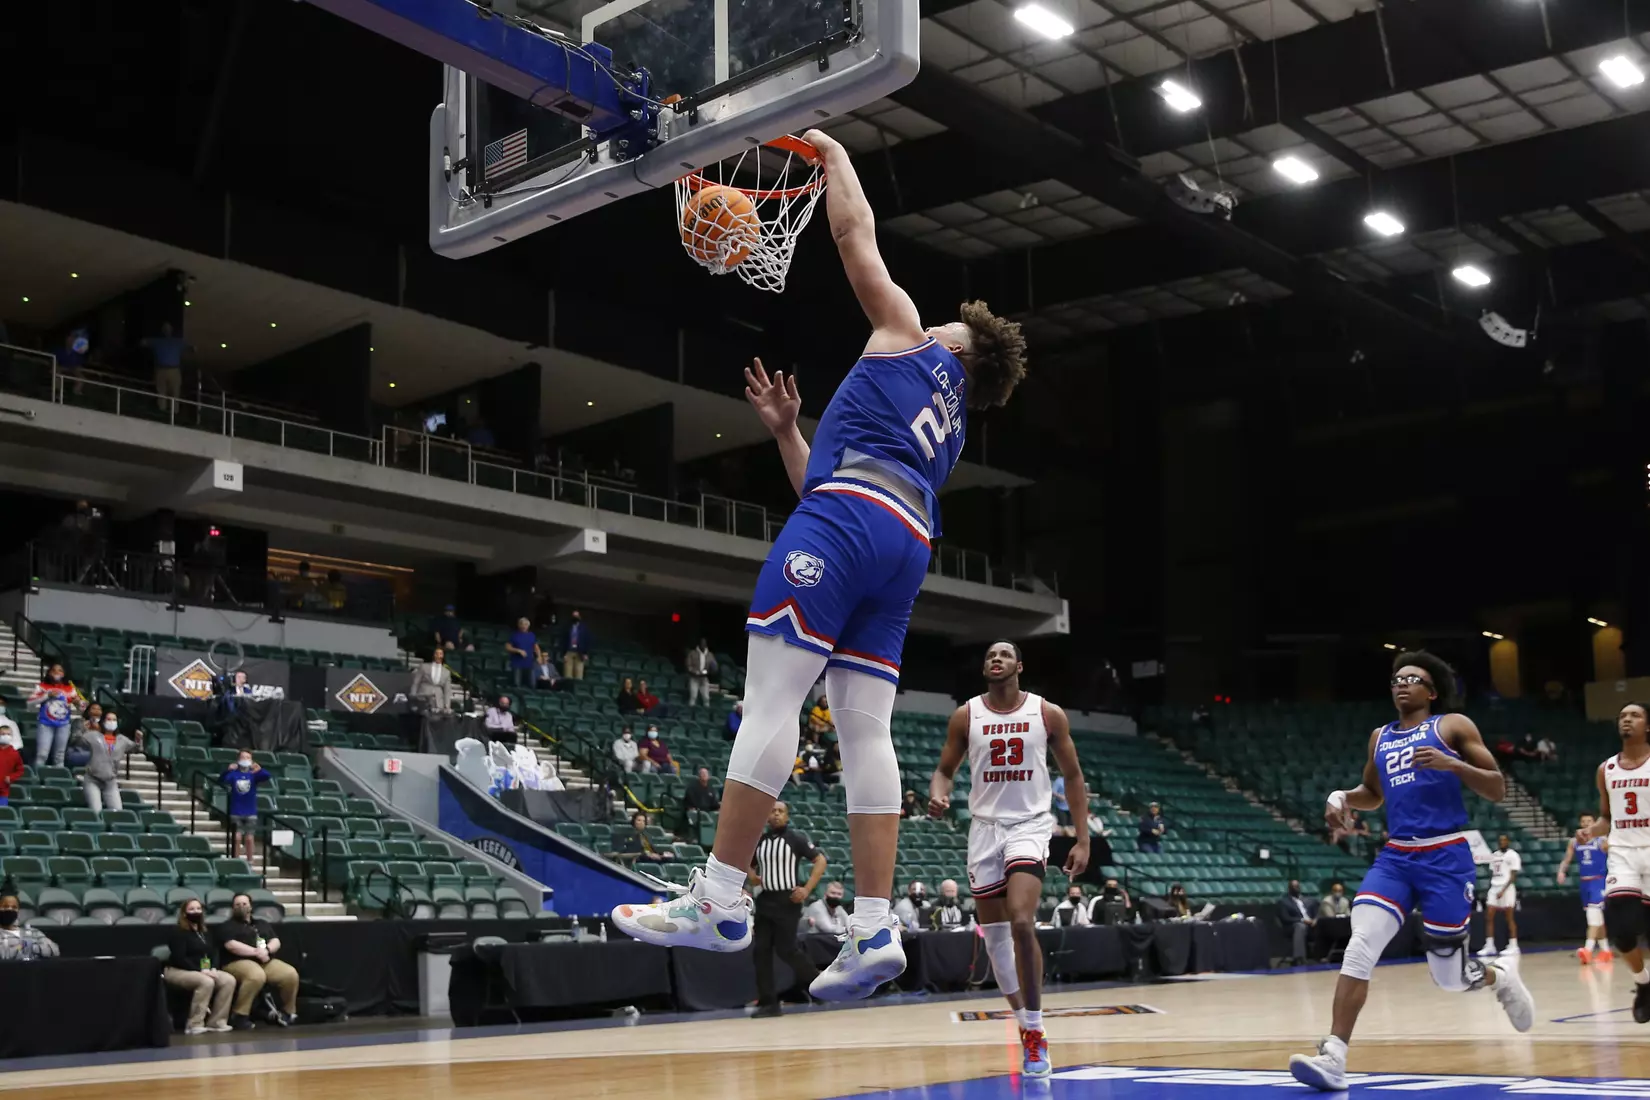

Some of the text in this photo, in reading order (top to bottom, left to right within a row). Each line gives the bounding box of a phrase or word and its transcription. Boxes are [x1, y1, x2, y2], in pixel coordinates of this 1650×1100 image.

[686, 195, 725, 230] Wilon
[932, 362, 960, 418] LOFTON
[952, 415, 962, 438] JR.
[910, 391, 952, 461] 2
[184, 678, 213, 691] NIT
[349, 692, 377, 703] NIT
[982, 721, 1030, 736] WESTERN
[990, 737, 1024, 767] 23
[1385, 746, 1415, 775] 22
[983, 769, 1034, 783] KENTUCKY
[1389, 771, 1416, 788] TECH
[1623, 791, 1638, 815] 3
